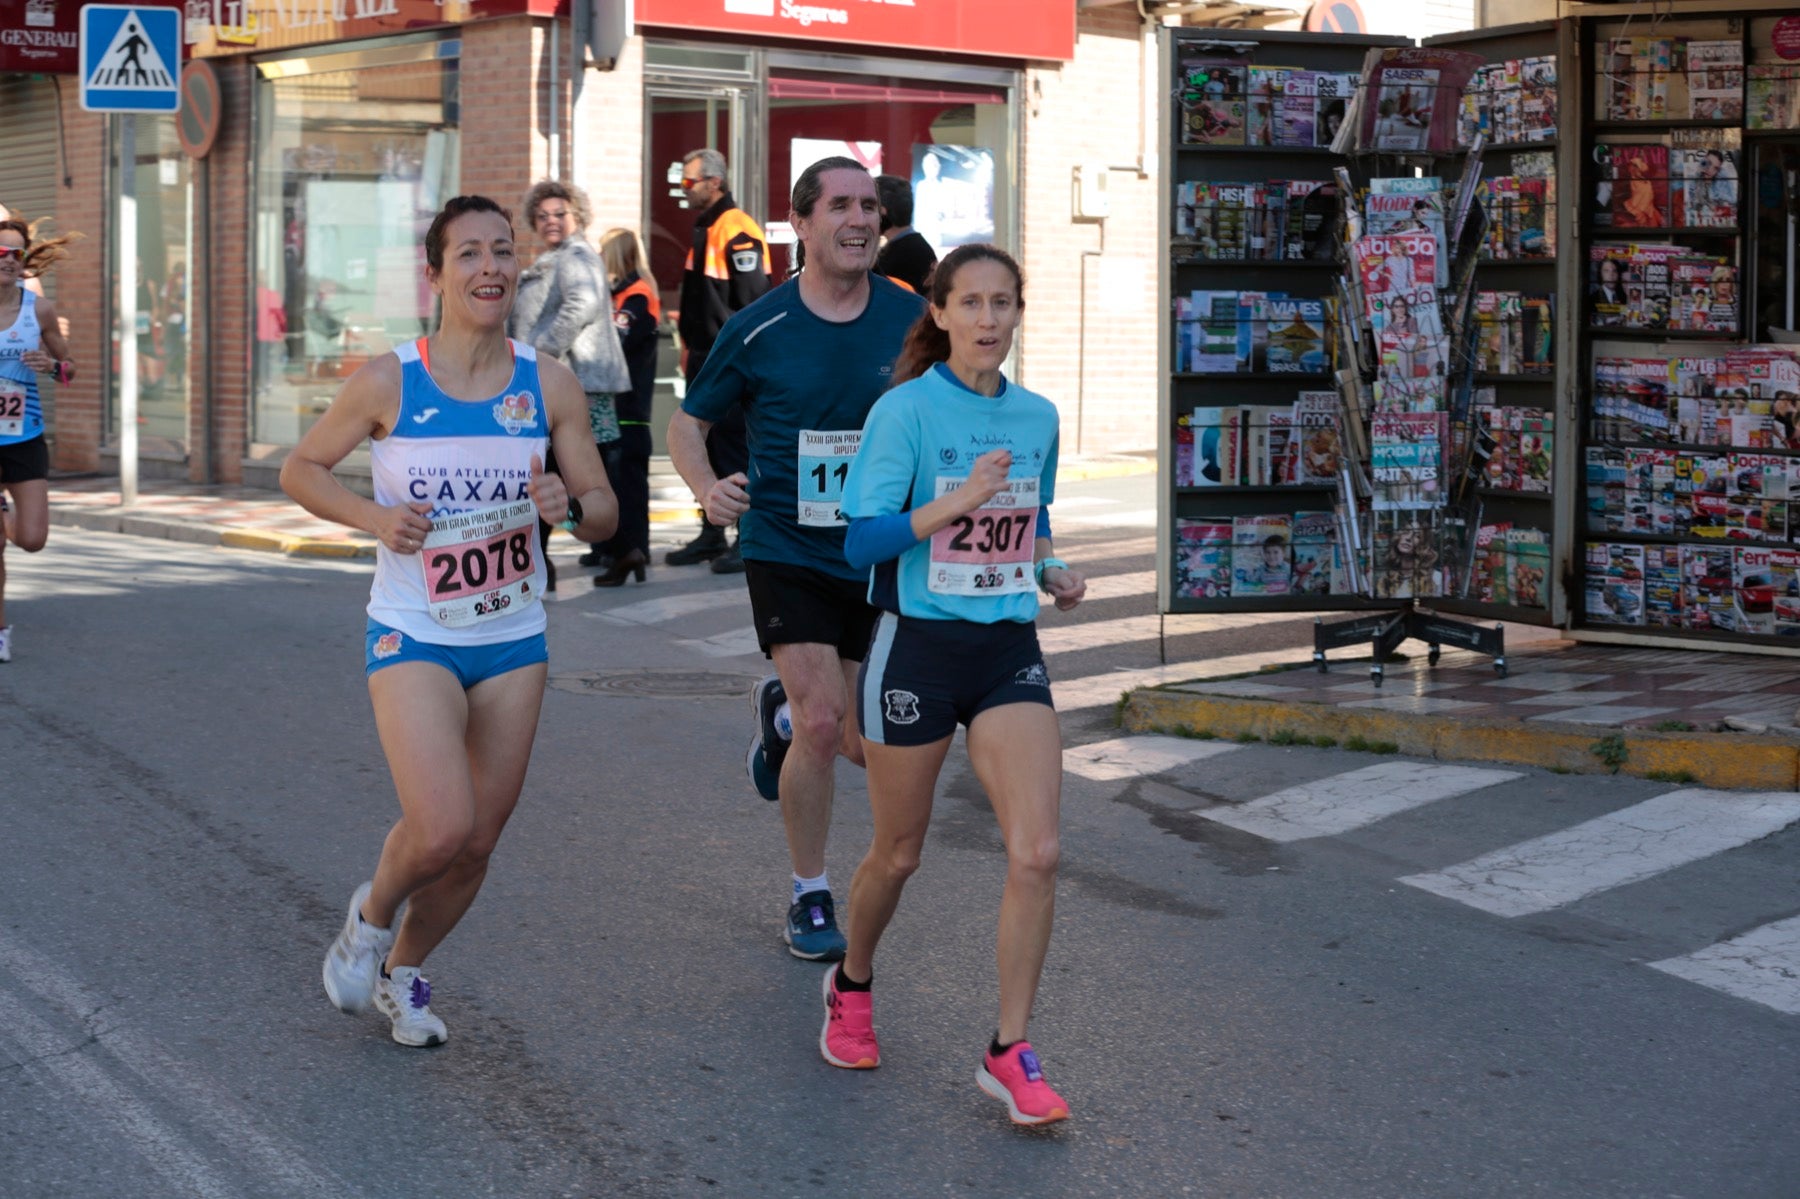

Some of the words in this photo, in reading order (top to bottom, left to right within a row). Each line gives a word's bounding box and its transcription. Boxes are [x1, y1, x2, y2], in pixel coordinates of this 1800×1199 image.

[780, 0, 848, 26] Seguros
[1, 29, 78, 48] GENERALI
[1385, 69, 1425, 80] SABER
[825, 434, 843, 445] GRAN
[408, 466, 447, 477] CLUB
[449, 515, 470, 530] GRAN
[471, 509, 499, 525] PREMIO
[499, 507, 509, 520] DE
[510, 502, 531, 516] FONDO
[948, 515, 1031, 553] 2307
[431, 532, 530, 595] 2078
